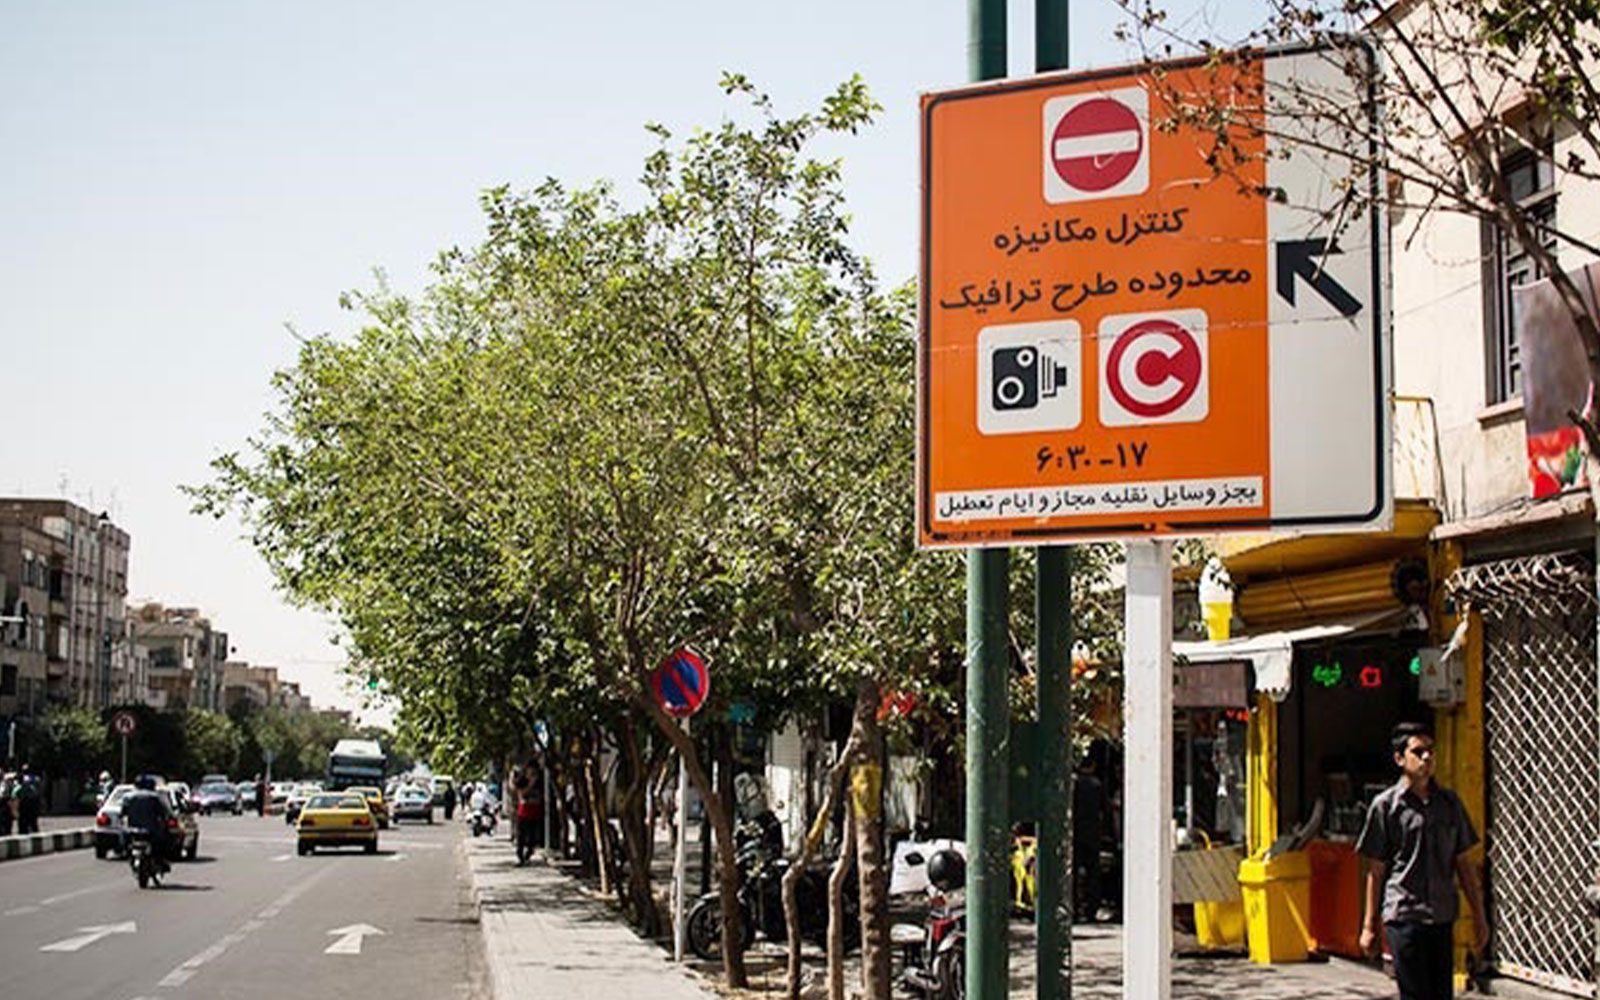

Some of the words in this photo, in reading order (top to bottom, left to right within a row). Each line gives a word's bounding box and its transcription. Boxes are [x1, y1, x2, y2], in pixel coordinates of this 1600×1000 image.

[993, 218, 1098, 255] مکانیزه
[1105, 208, 1189, 245] کنترل
[1050, 273, 1120, 312] طرح
[1128, 265, 1253, 299] محدوده
[939, 280, 1042, 314] ترافیک
[1118, 332, 1186, 404] C
[999, 492, 1034, 515] ایام
[1039, 495, 1050, 513] و
[1052, 491, 1096, 513] مجاز
[1101, 487, 1148, 508] نقلیه
[1153, 485, 1216, 508] وسایل
[1218, 484, 1257, 505] بجز
[939, 495, 994, 518] تعطیل
